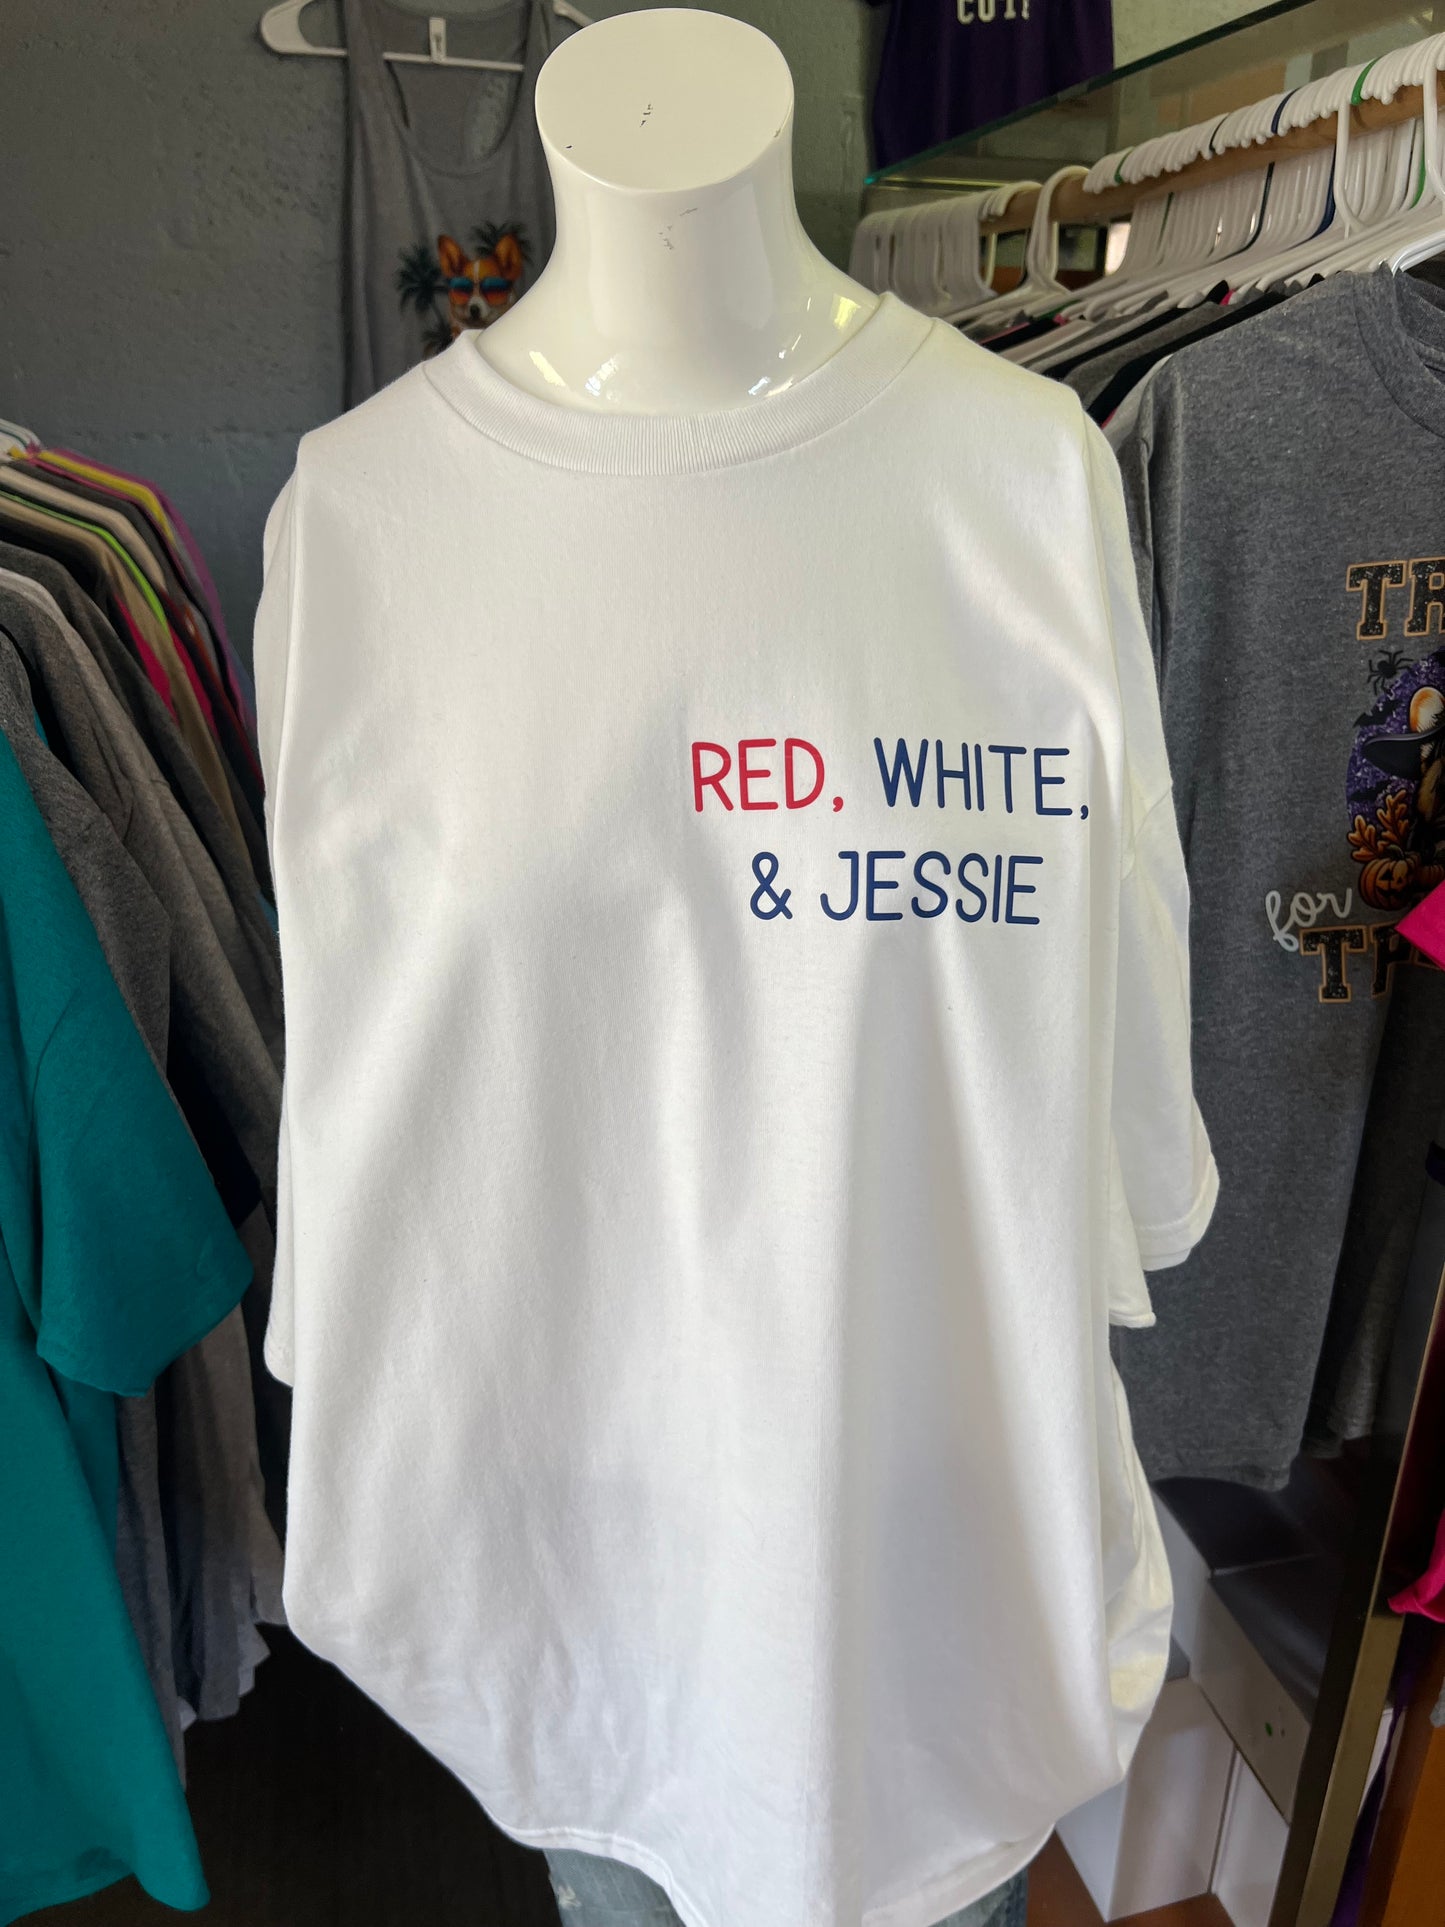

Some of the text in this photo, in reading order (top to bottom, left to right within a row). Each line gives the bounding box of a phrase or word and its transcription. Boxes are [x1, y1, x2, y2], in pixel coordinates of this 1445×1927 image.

[692, 737, 1089, 820] RED, WHITE,
[750, 850, 1044, 924] & JESSIE
[1265, 888, 1353, 952] for
